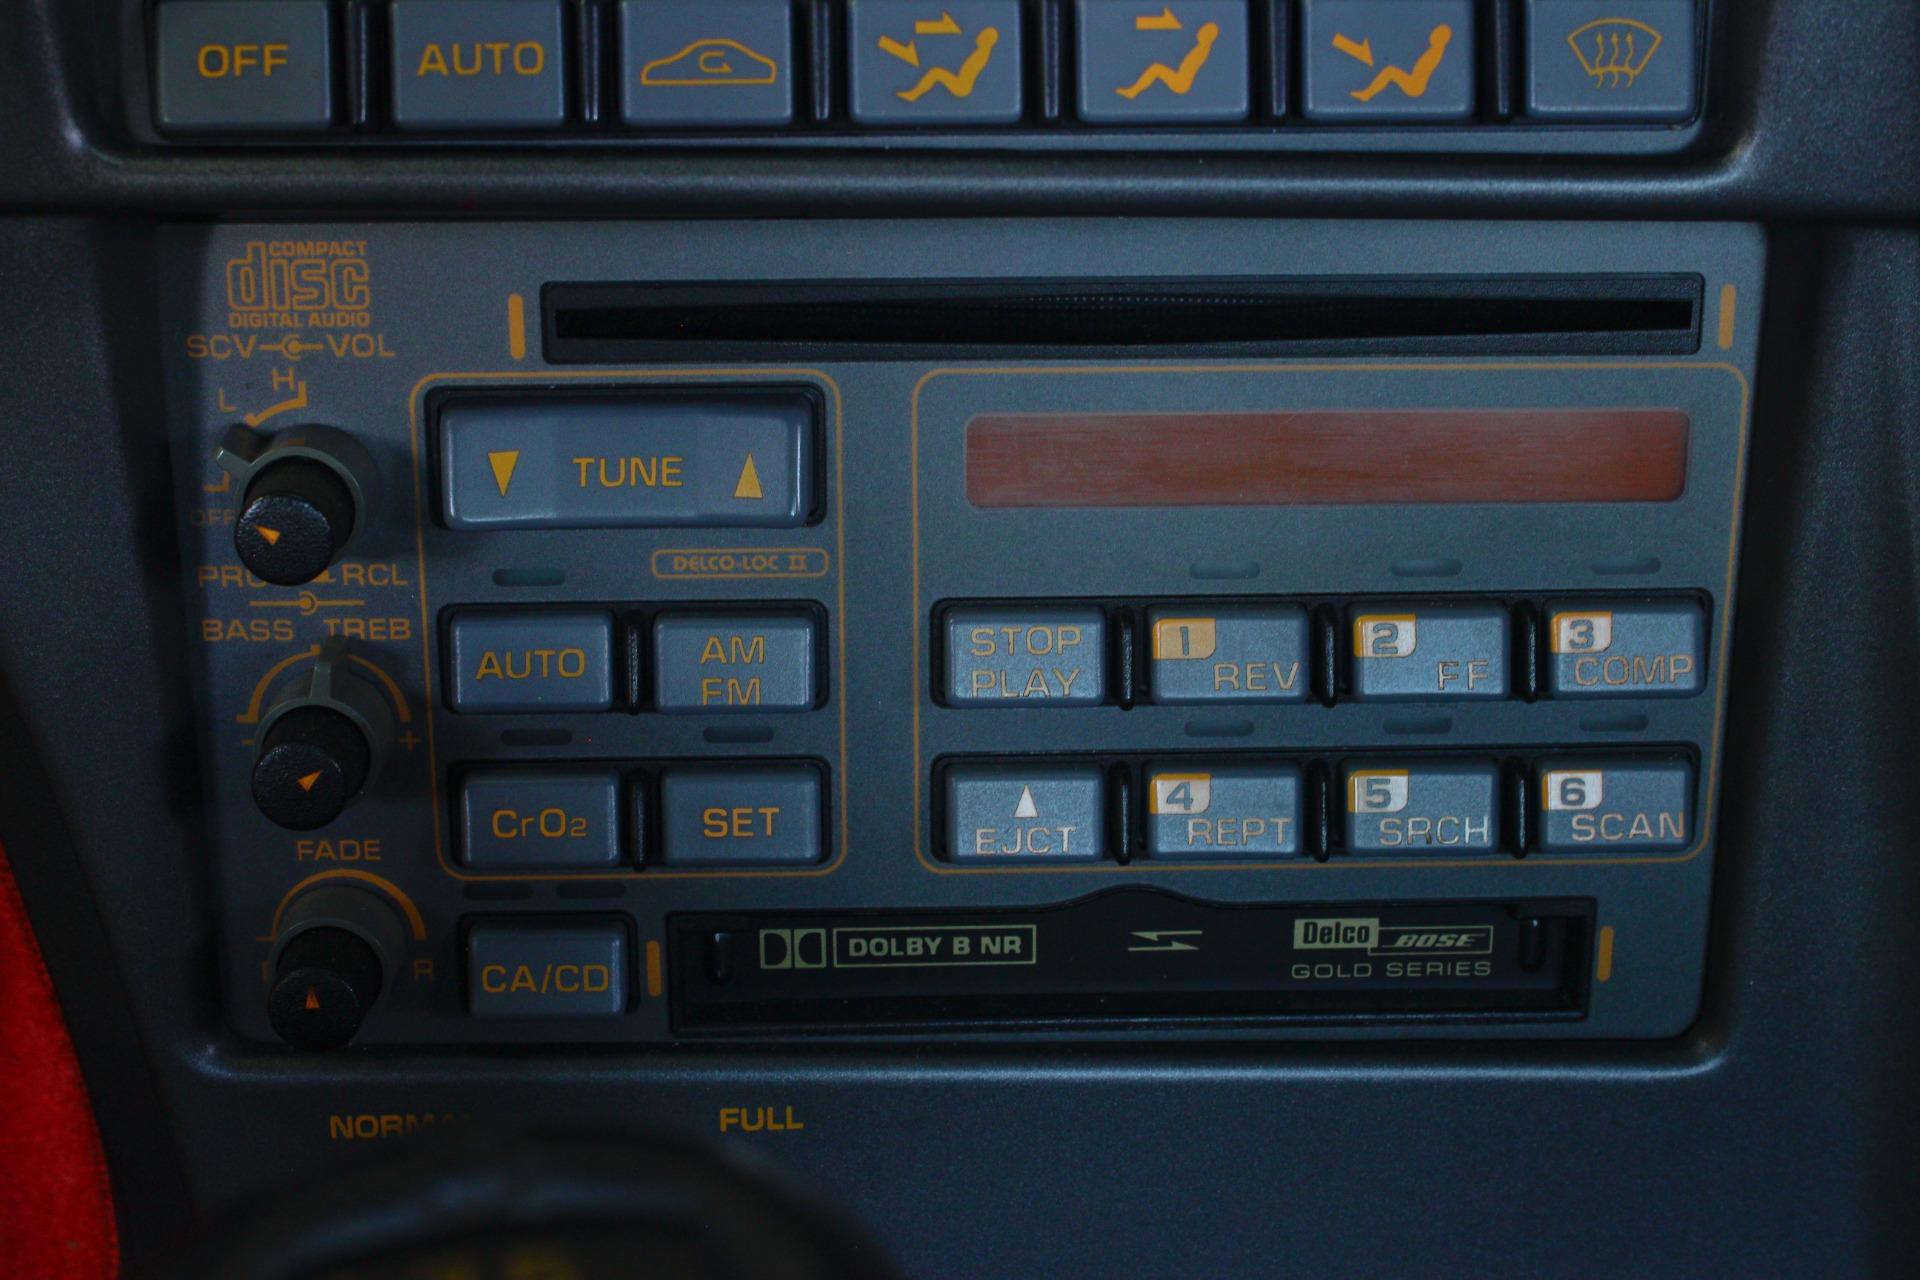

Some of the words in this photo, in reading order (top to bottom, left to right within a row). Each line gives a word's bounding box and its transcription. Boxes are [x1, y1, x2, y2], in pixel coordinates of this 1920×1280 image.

[197, 43, 289, 79] OFF
[416, 40, 545, 77] AUTO
[268, 240, 367, 257] COMPACT
[227, 312, 303, 328] DIGITAL
[308, 311, 371, 328] AUDIO
[186, 334, 257, 359] SCV
[327, 333, 396, 357] VOL
[271, 368, 295, 391] H
[218, 387, 236, 412] L
[572, 456, 684, 488] TUNE
[341, 563, 409, 586] RCL
[202, 618, 295, 642] BASS
[323, 617, 412, 641] TREB
[970, 626, 1082, 656] STOP
[1179, 626, 1190, 656] 1
[1372, 623, 1399, 655] 2
[1568, 620, 1594, 649] 3
[475, 648, 587, 680] AUTO
[700, 635, 766, 665] AM
[971, 669, 1081, 698] PLAY
[1213, 663, 1300, 692] REV
[1436, 659, 1489, 691] FF
[1574, 655, 1694, 686] COMP
[701, 678, 762, 706] FM
[1166, 782, 1194, 811] 4
[1365, 778, 1391, 808] 5
[1560, 778, 1586, 805] 6
[491, 808, 588, 839] CrO2
[703, 808, 780, 837] SET
[1187, 818, 1292, 846] REPT
[1379, 815, 1490, 846] SRCH
[1571, 812, 1685, 842] SCAN
[297, 839, 382, 861] FADE
[975, 827, 1077, 856] EJCT
[849, 937, 941, 957] DOLBY
[953, 937, 970, 955] B
[981, 936, 1021, 955] NR
[1302, 921, 1371, 945] Delco
[1395, 933, 1479, 948] BOSE
[481, 964, 609, 993] CA/CD
[1291, 963, 1372, 979] GOLD
[1385, 960, 1492, 978] SERIES
[329, 1113, 471, 1140] NORM
[719, 1106, 804, 1132] FULL
